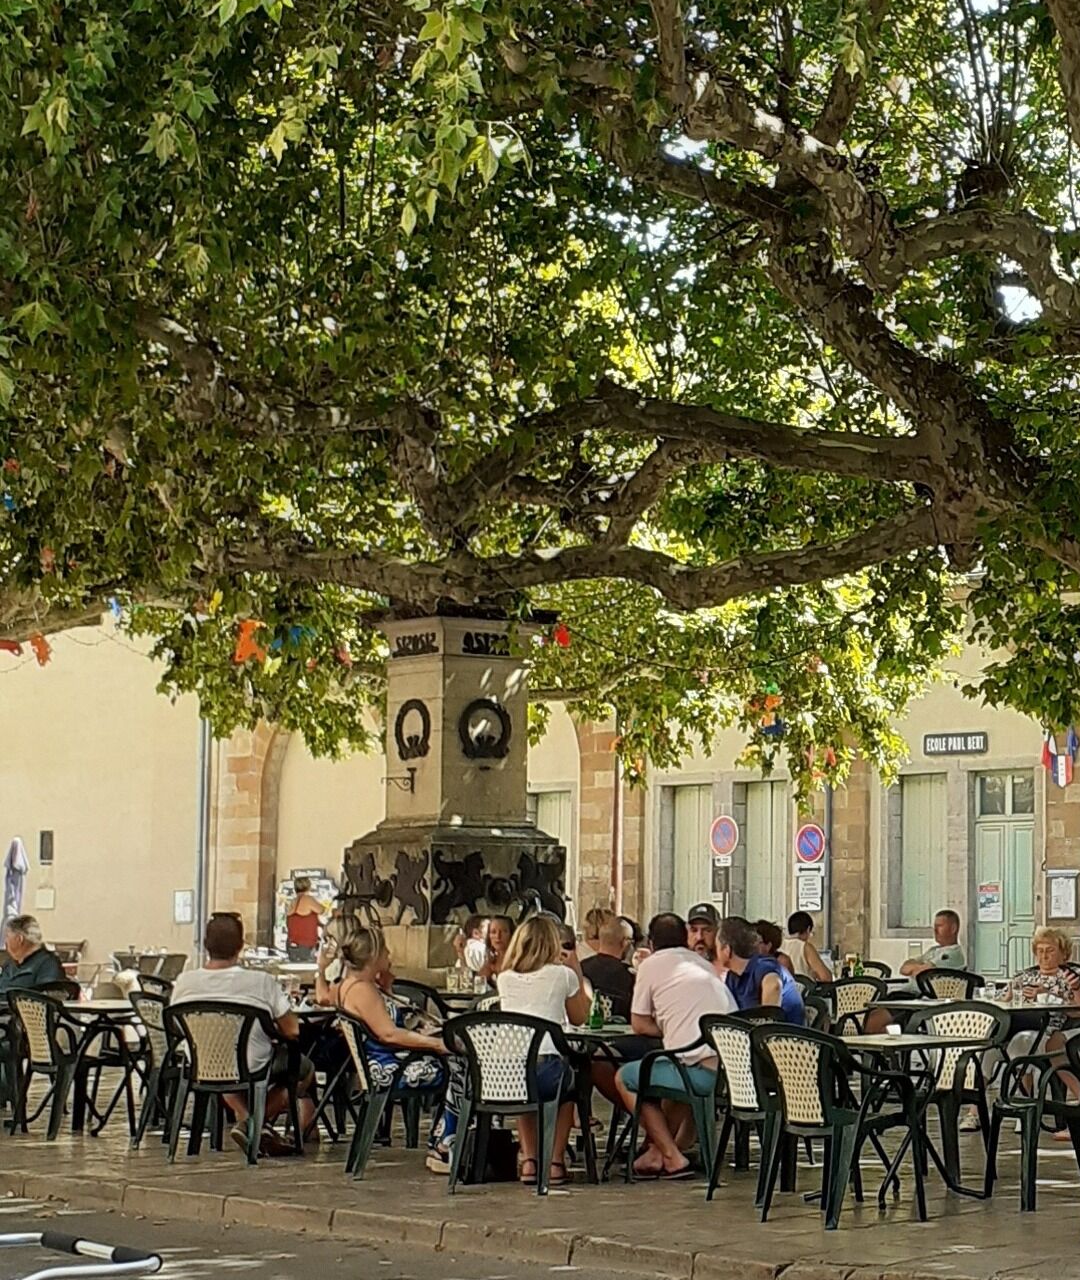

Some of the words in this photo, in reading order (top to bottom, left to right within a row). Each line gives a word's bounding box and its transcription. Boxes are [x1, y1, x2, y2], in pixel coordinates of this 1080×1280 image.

[926, 737, 947, 752] ECOLE
[948, 736, 966, 751] PAUL
[967, 735, 985, 750] BERT
